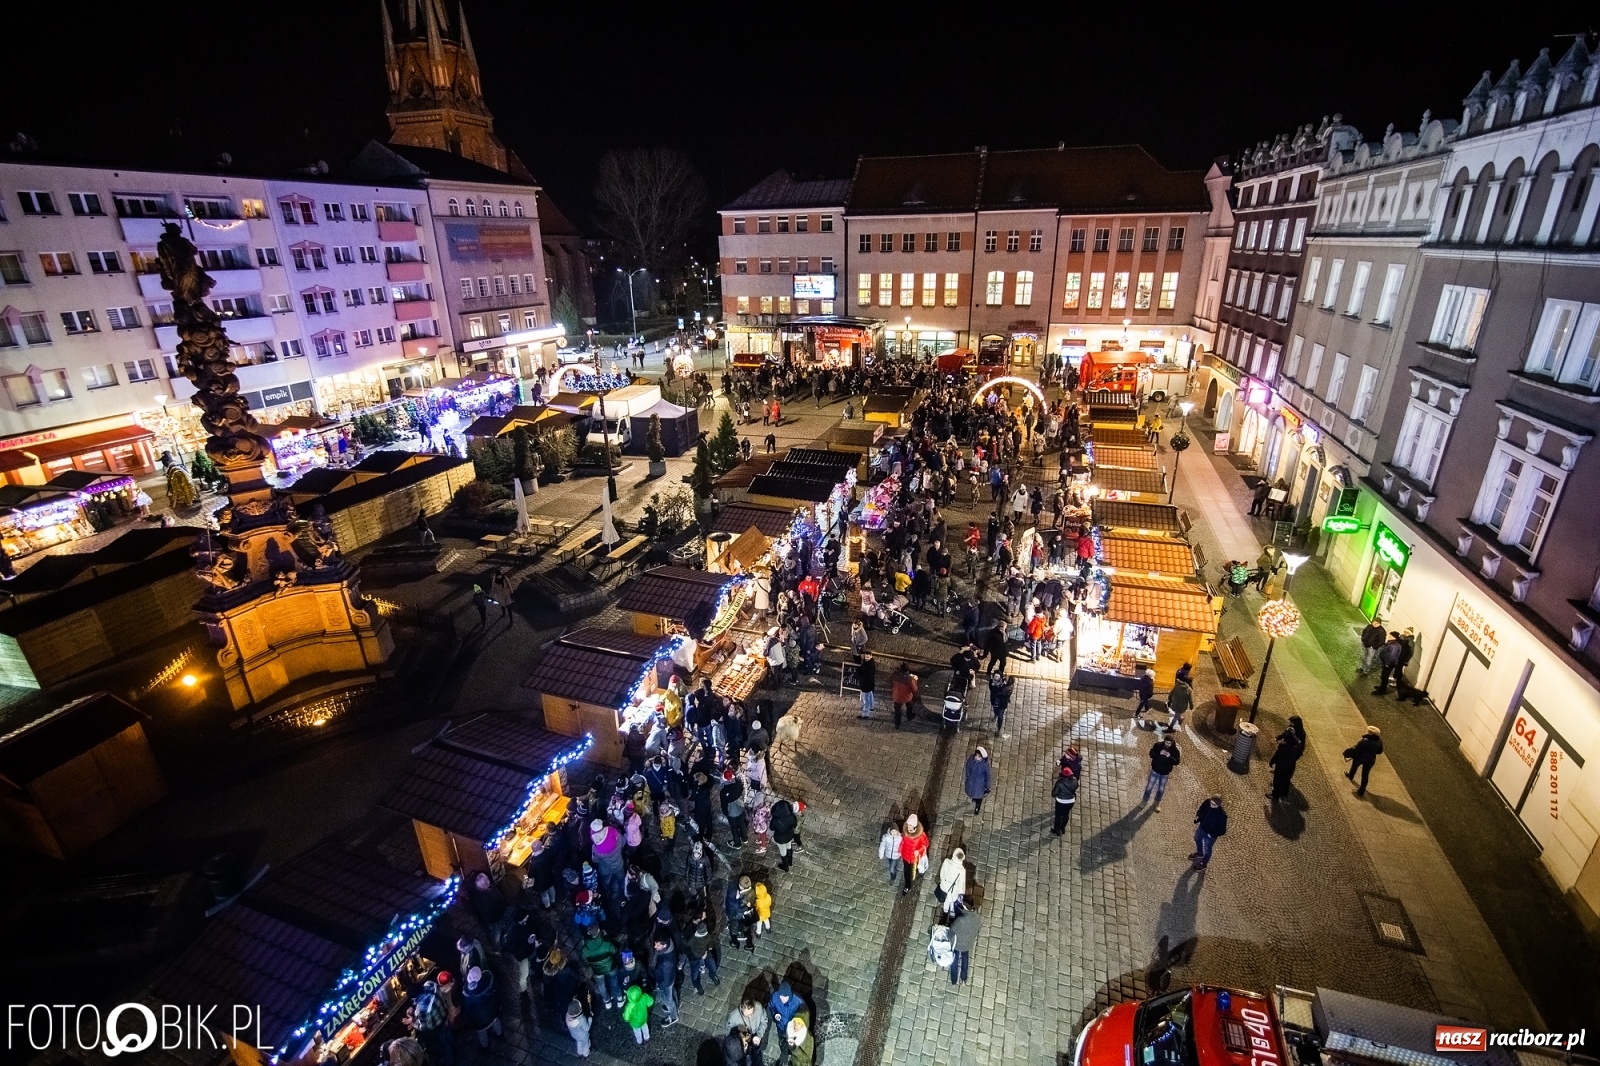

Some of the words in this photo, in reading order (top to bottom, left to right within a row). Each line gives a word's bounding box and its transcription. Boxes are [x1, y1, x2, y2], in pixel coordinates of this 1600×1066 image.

[265, 389, 288, 401] empik
[1458, 596, 1475, 616] LOKAL
[1475, 613, 1484, 623] DO
[1457, 617, 1469, 633] 880
[1469, 629, 1482, 646] 201
[1483, 643, 1496, 659] 117
[1510, 735, 1526, 754] LOKAL
[1526, 752, 1535, 764] DO
[1550, 750, 1558, 772] 880
[1550, 774, 1558, 795] 201
[1550, 798, 1558, 820] 117
[323, 969, 387, 1038] ZAKRĘCONY
